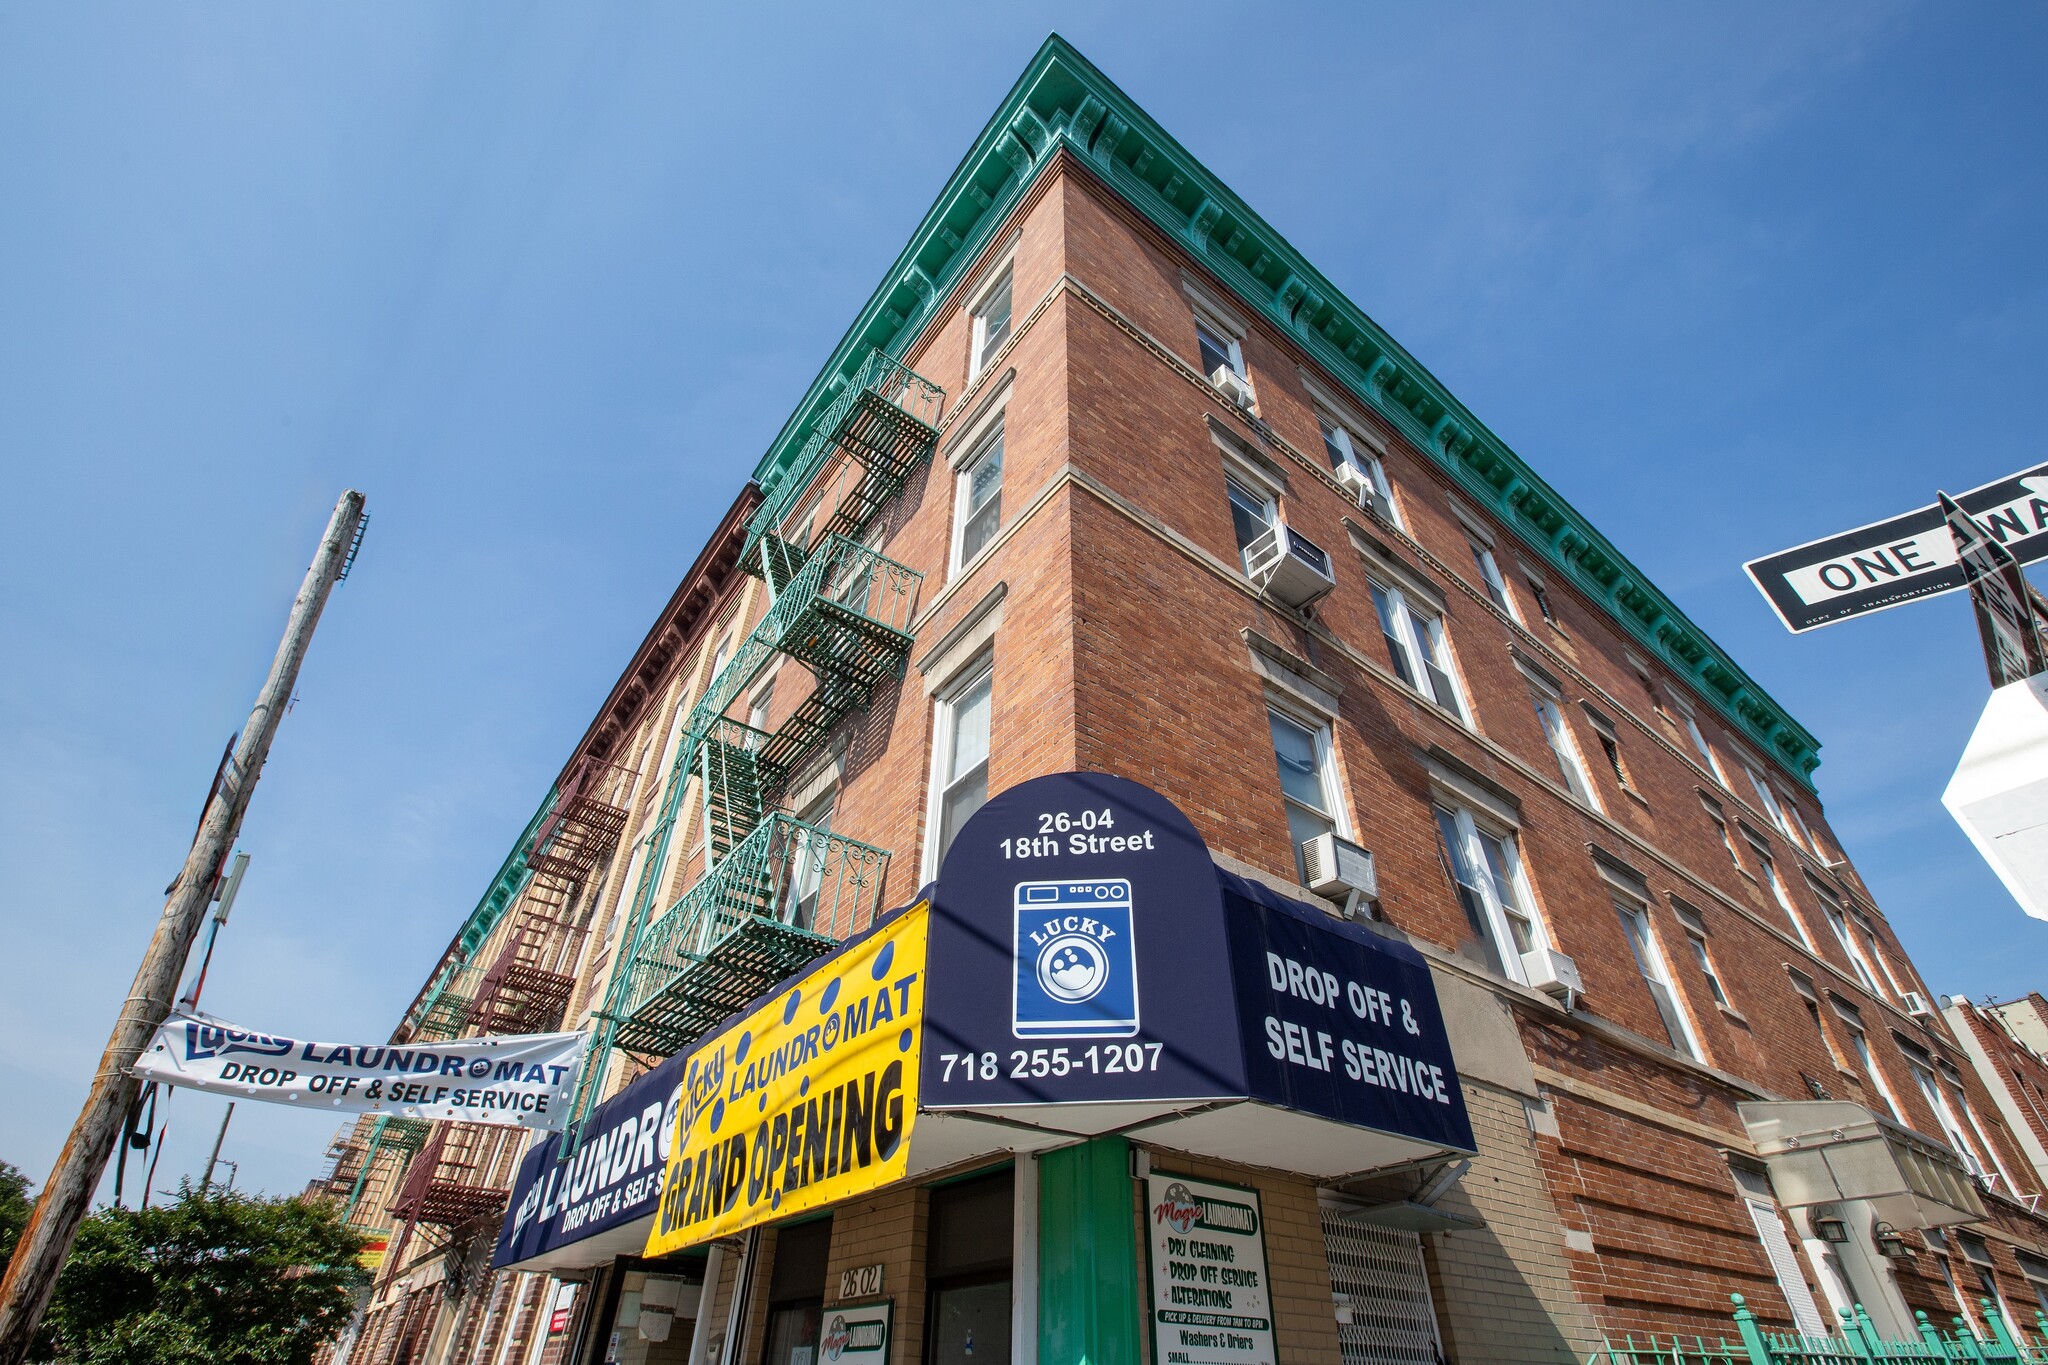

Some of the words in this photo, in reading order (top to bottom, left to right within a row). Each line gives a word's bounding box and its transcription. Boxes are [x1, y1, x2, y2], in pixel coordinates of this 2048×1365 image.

[1818, 540, 1937, 591] ONE
[1806, 614, 1830, 625] DEPT
[1840, 607, 1852, 615] OF
[1862, 582, 1951, 608] TRANSPORTATION
[1038, 808, 1115, 834] 26-04
[1000, 834, 1059, 859] 18th
[1068, 829, 1155, 854] Street
[1029, 914, 1117, 947] LUCKY
[1266, 951, 1340, 1009] DROP
[1347, 982, 1393, 1027] OFF
[1401, 999, 1421, 1037] &
[940, 1053, 998, 1083] 718
[1010, 1042, 1164, 1080] 255-1207
[1264, 1015, 1335, 1073] SELF
[1341, 1039, 1450, 1105] SERVICE
[219, 1062, 297, 1087] DROP
[308, 1075, 360, 1097] OFF
[365, 1079, 383, 1100] &
[388, 1082, 449, 1105] SELF
[451, 1088, 550, 1113] SERVICE
[660, 1133, 747, 1237] GRAND
[747, 1060, 905, 1207] OPENING
[561, 1201, 590, 1233] DROP
[589, 1190, 615, 1223] OFF
[611, 1188, 621, 1215] &
[623, 1174, 655, 1209] SELF
[1154, 1201, 1203, 1231] Magic
[1203, 1201, 1254, 1231] LAUNDROMAT
[1168, 1237, 1187, 1257] DRY
[1190, 1240, 1235, 1263] CLEANING
[1169, 1260, 1197, 1282] DROP
[1200, 1267, 1219, 1284] OFF
[1221, 1269, 1259, 1288] SERVICE
[1171, 1285, 1232, 1309] ALTERATIONS
[1165, 1312, 1177, 1322] PICK
[1178, 1313, 1185, 1322] UP
[1192, 1314, 1217, 1325] DELIVERY
[1217, 1316, 1232, 1326] FROM
[1244, 1318, 1251, 1328] TO
[849, 1324, 883, 1348] LAUNDROMAT
[1179, 1330, 1218, 1348] Washers
[1220, 1333, 1225, 1348] &
[1227, 1333, 1253, 1350] Driers
